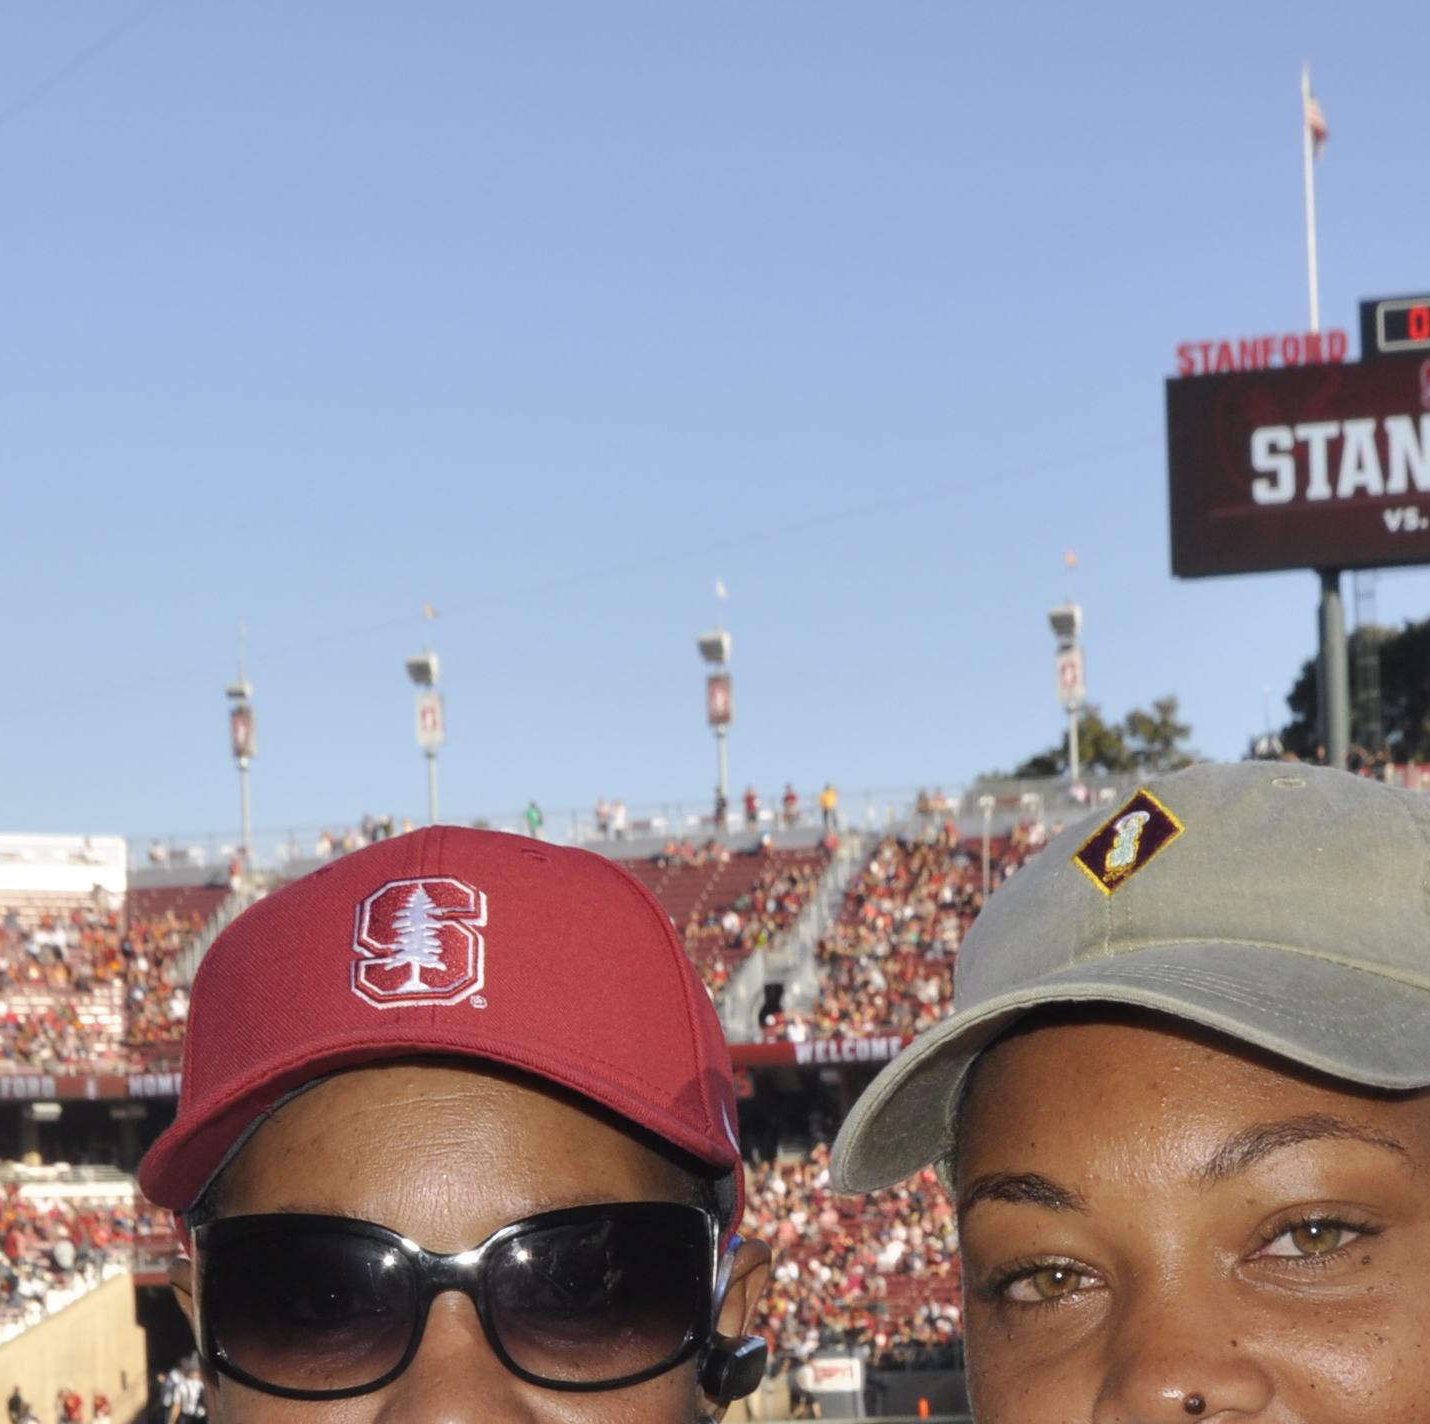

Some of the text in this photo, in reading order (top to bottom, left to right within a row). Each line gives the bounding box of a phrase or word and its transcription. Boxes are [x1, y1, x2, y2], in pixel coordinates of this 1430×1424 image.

[1177, 330, 1347, 376] STANFORD
[1383, 505, 1429, 533] vs.
[794, 1036, 903, 1065] WELCOME
